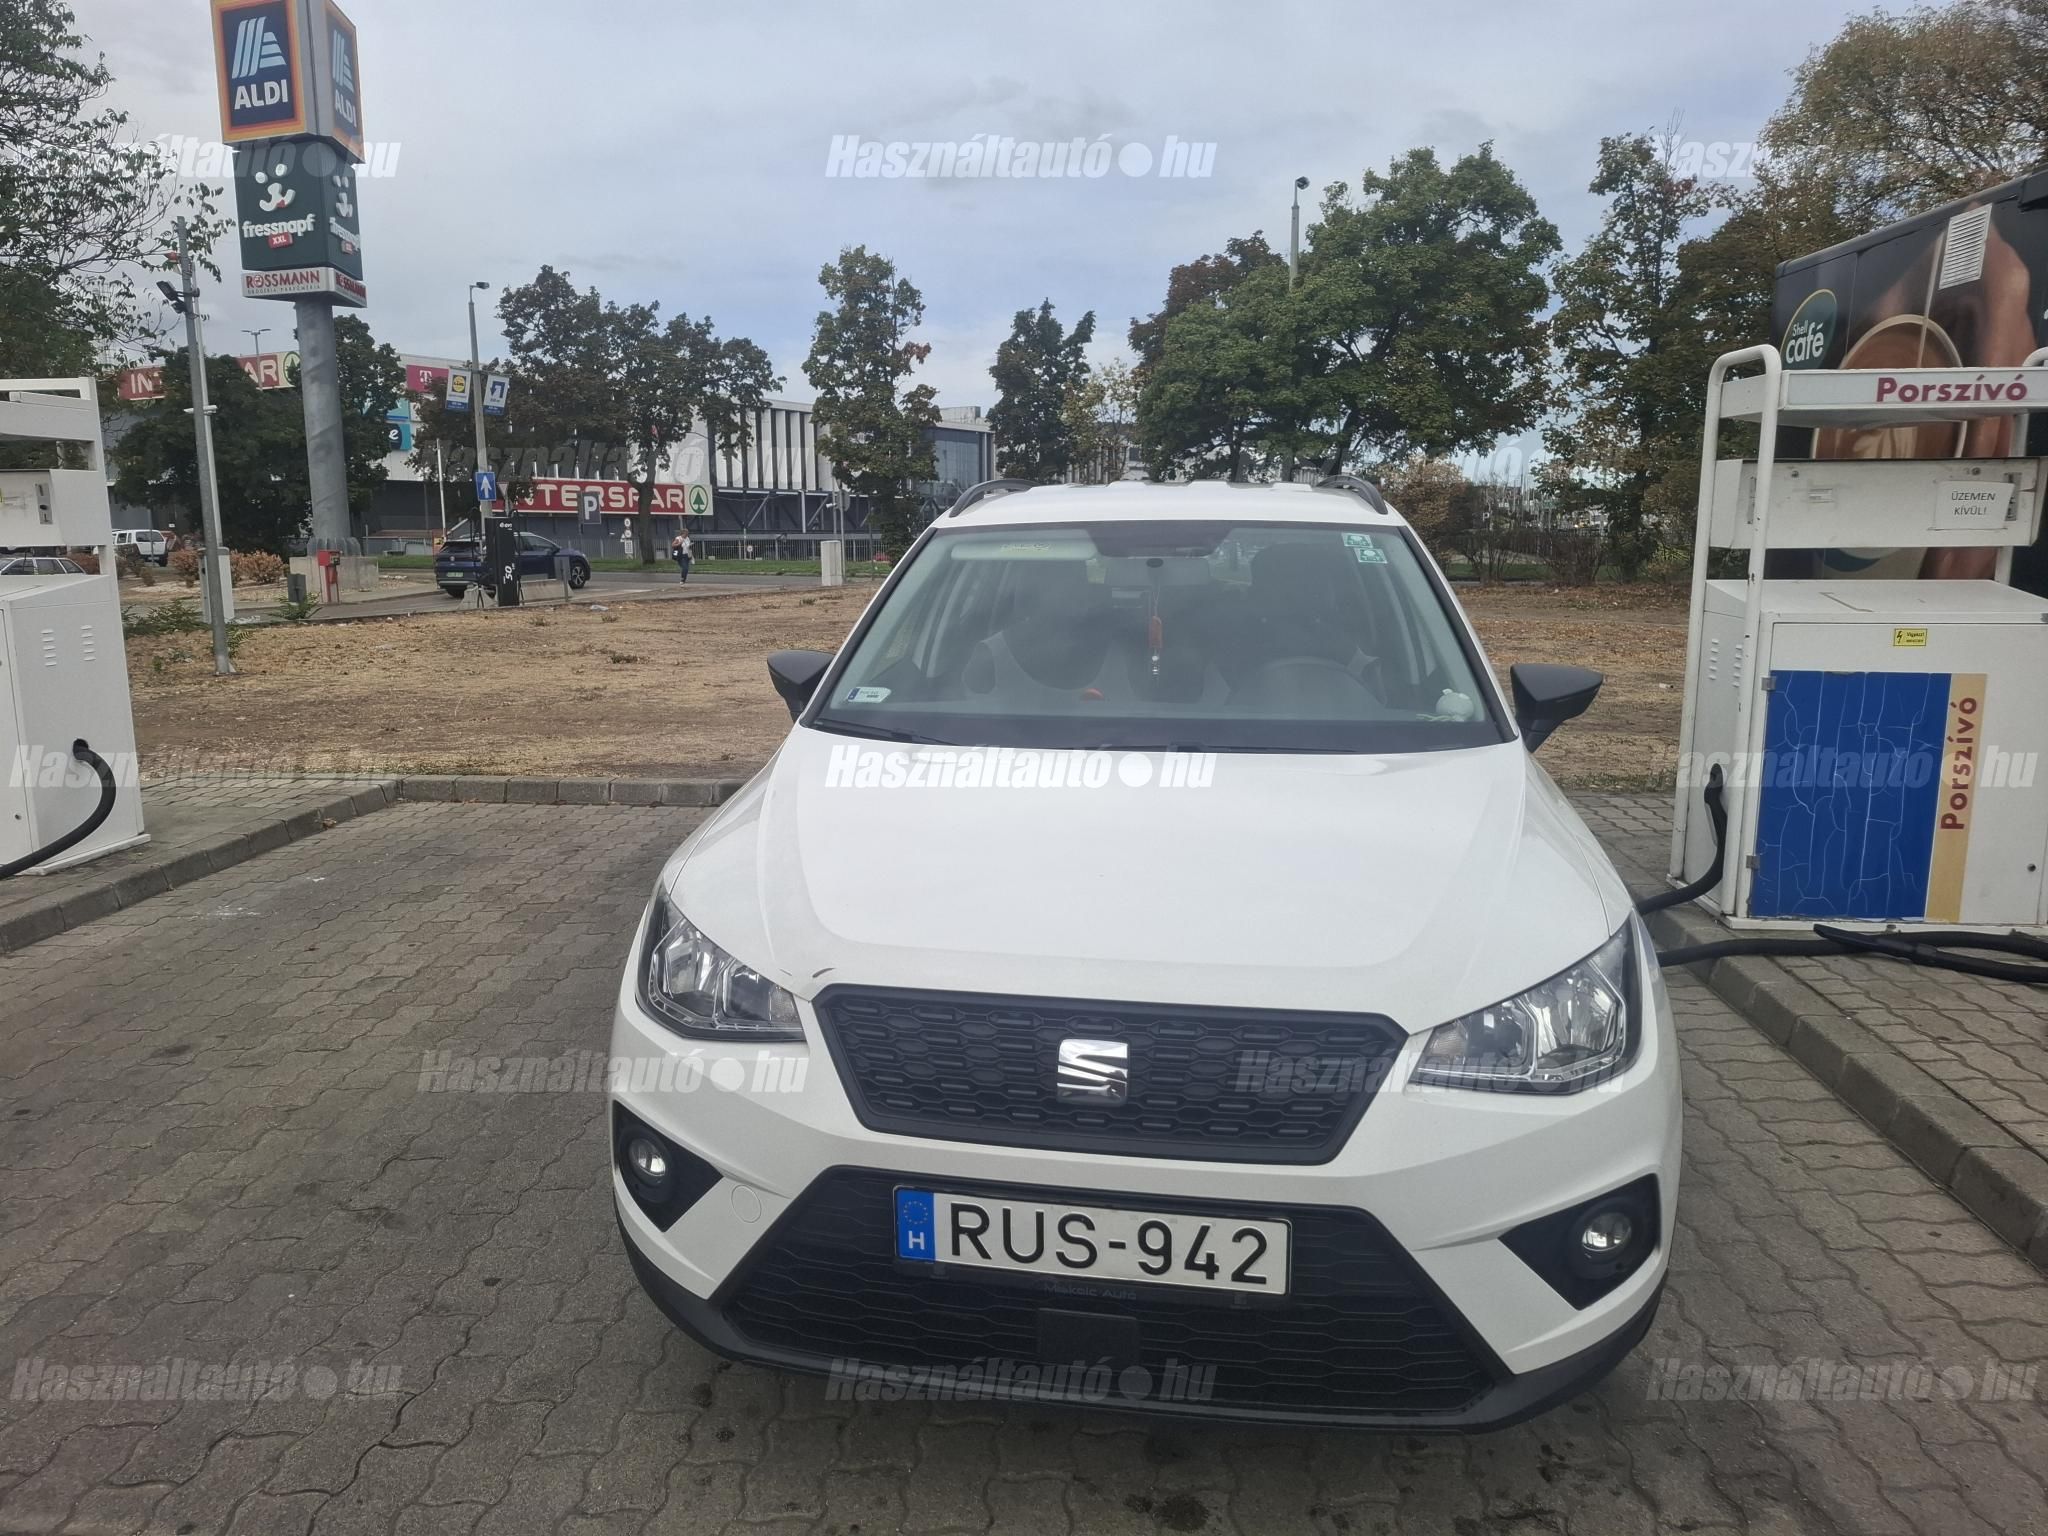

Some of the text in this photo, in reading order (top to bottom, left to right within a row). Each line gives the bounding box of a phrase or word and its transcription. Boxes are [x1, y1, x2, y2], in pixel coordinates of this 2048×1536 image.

[234, 79, 289, 110] ALDI
[334, 89, 357, 128] ALDI
[242, 213, 316, 238] fressnapf
[272, 235, 287, 245] XXL
[245, 270, 320, 288] ROSSMANN
[1792, 319, 1809, 336] Shell
[1785, 321, 1824, 364] café
[1876, 373, 2028, 403] Porszívó
[516, 483, 684, 509] TERSPAR
[584, 495, 598, 520] P
[1951, 490, 1996, 501] ÜZEMEN
[1940, 697, 1977, 830] Porszívó
[908, 1202, 1268, 1285] H RUS-942
